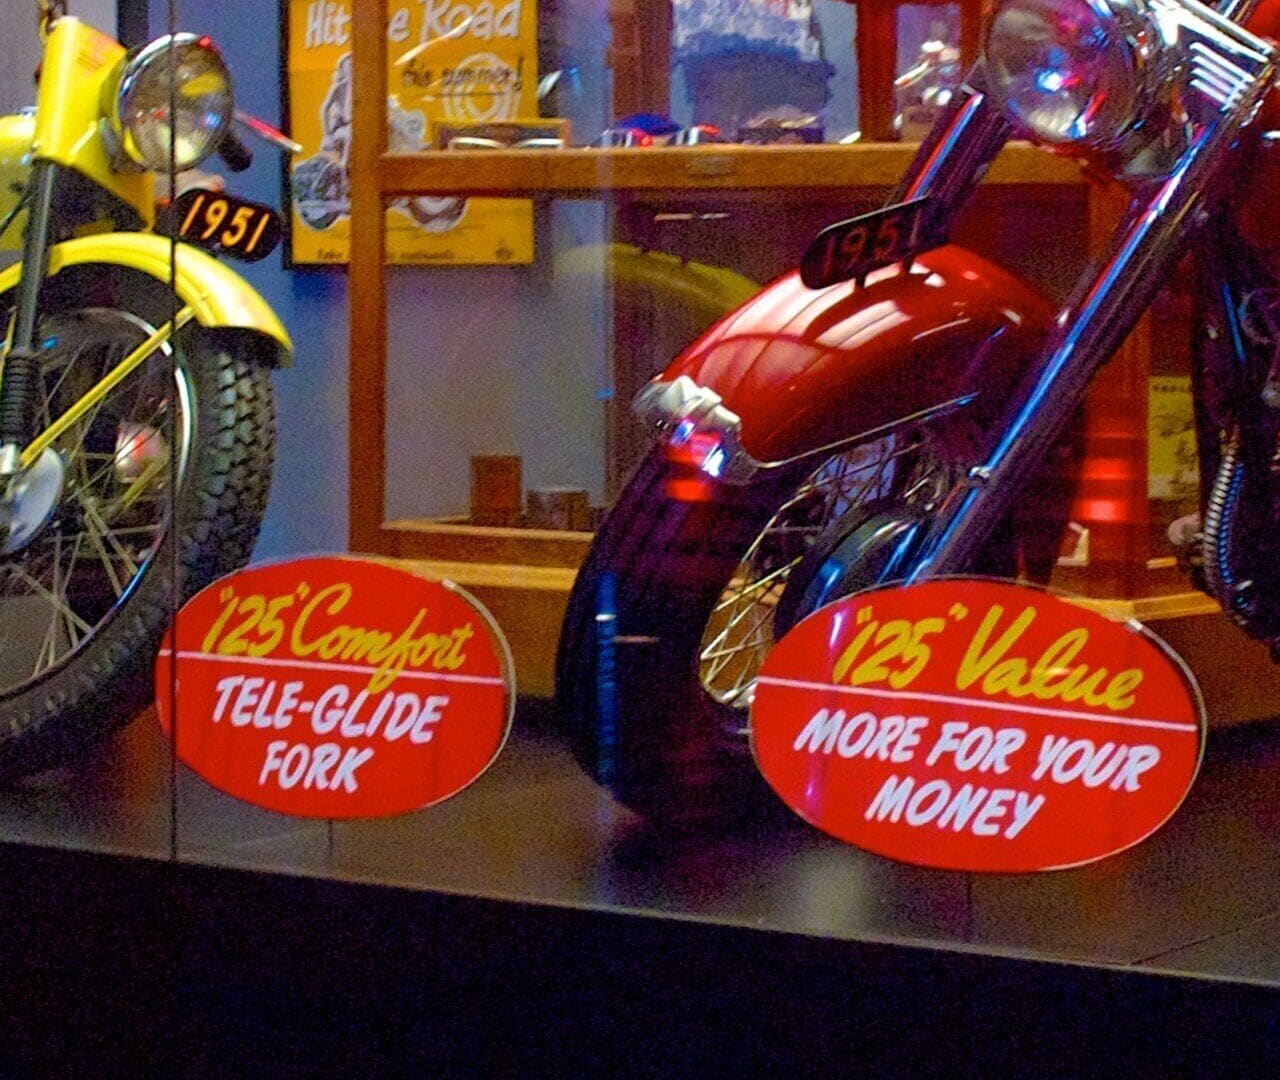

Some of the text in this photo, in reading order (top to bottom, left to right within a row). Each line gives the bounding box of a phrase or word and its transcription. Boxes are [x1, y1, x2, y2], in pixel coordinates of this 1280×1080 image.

[179, 193, 272, 255] 1951
[290, 582, 475, 695] Comfort
[955, 603, 1146, 711] Value
[211, 674, 451, 745] TELE-GLIDE
[258, 740, 376, 795] FORK
[792, 707, 1162, 794] MORE FOR YOUR
[863, 773, 1047, 842] MONEY
